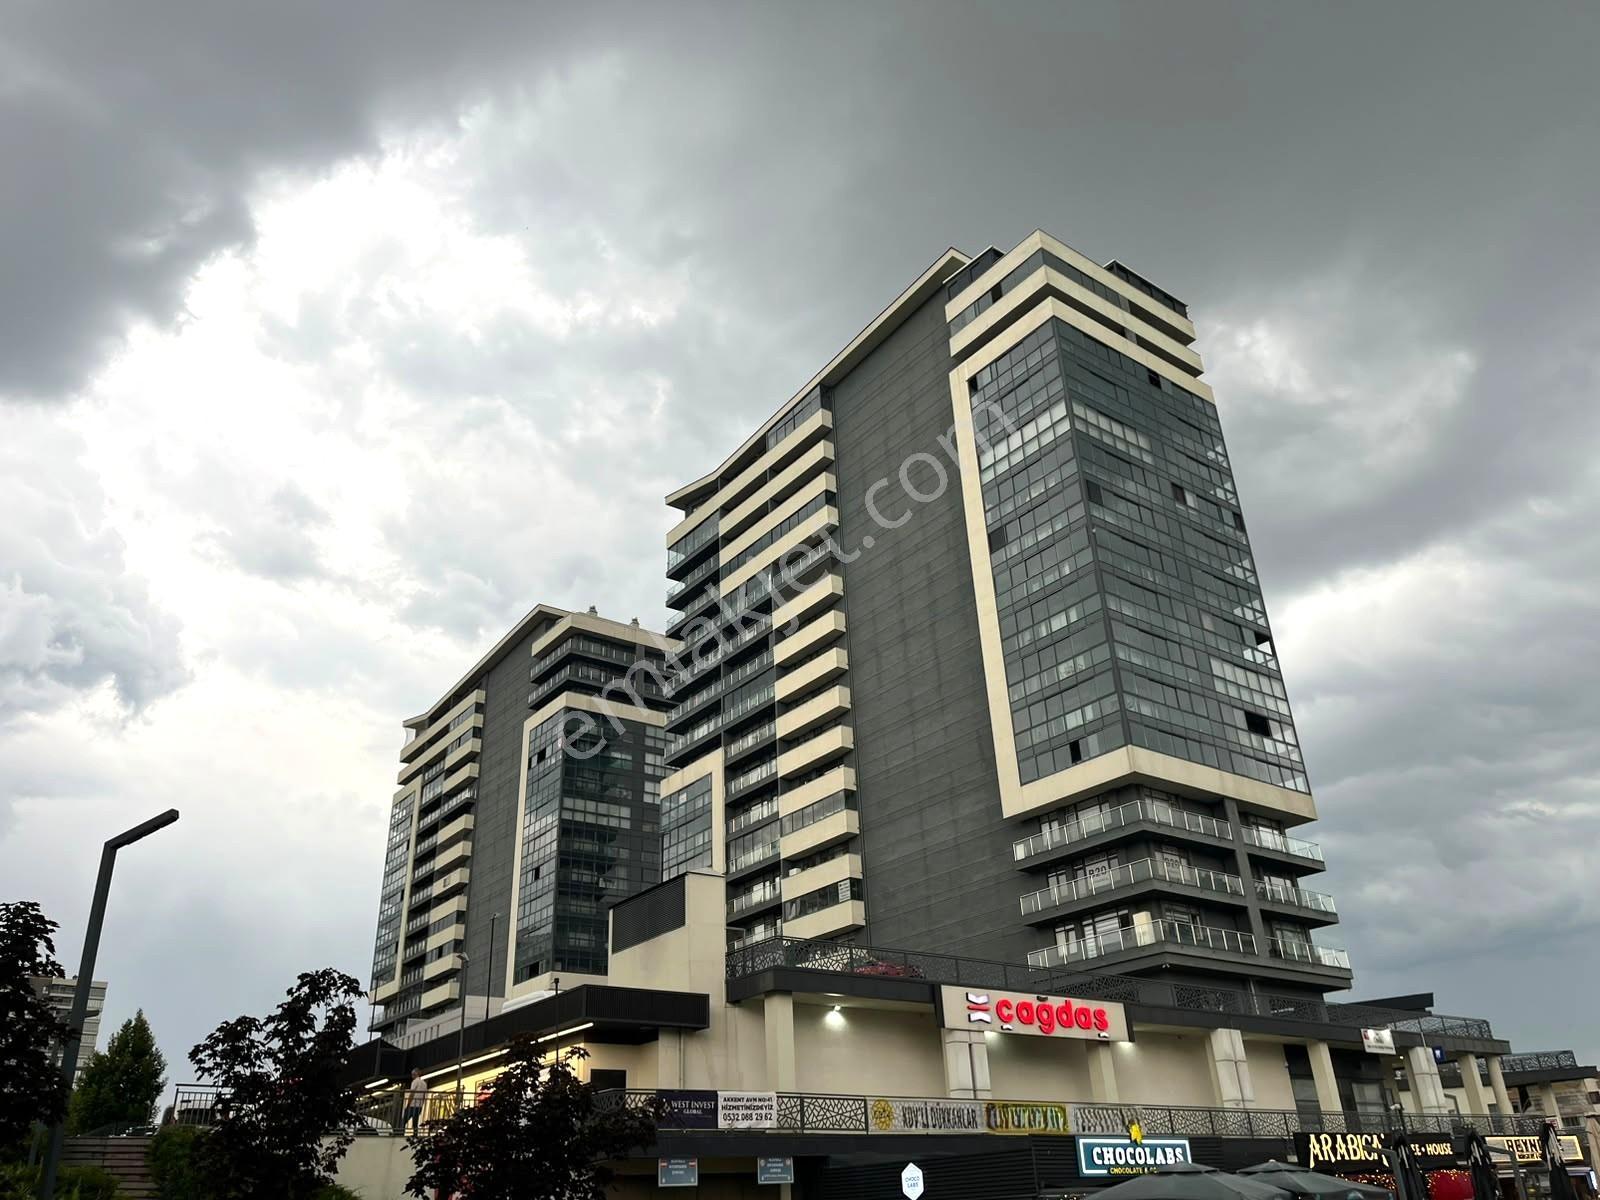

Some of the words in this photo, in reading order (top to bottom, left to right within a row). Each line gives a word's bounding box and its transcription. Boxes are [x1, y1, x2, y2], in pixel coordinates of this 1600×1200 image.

[671, 1100, 689, 1108] WEST
[690, 1101, 715, 1109] INVEST
[723, 1112, 740, 1121] 0532
[755, 1112, 763, 1121] 29
[1425, 1142, 1453, 1156] HOUSE
[1092, 1146, 1184, 1165] CHOCOLABS
